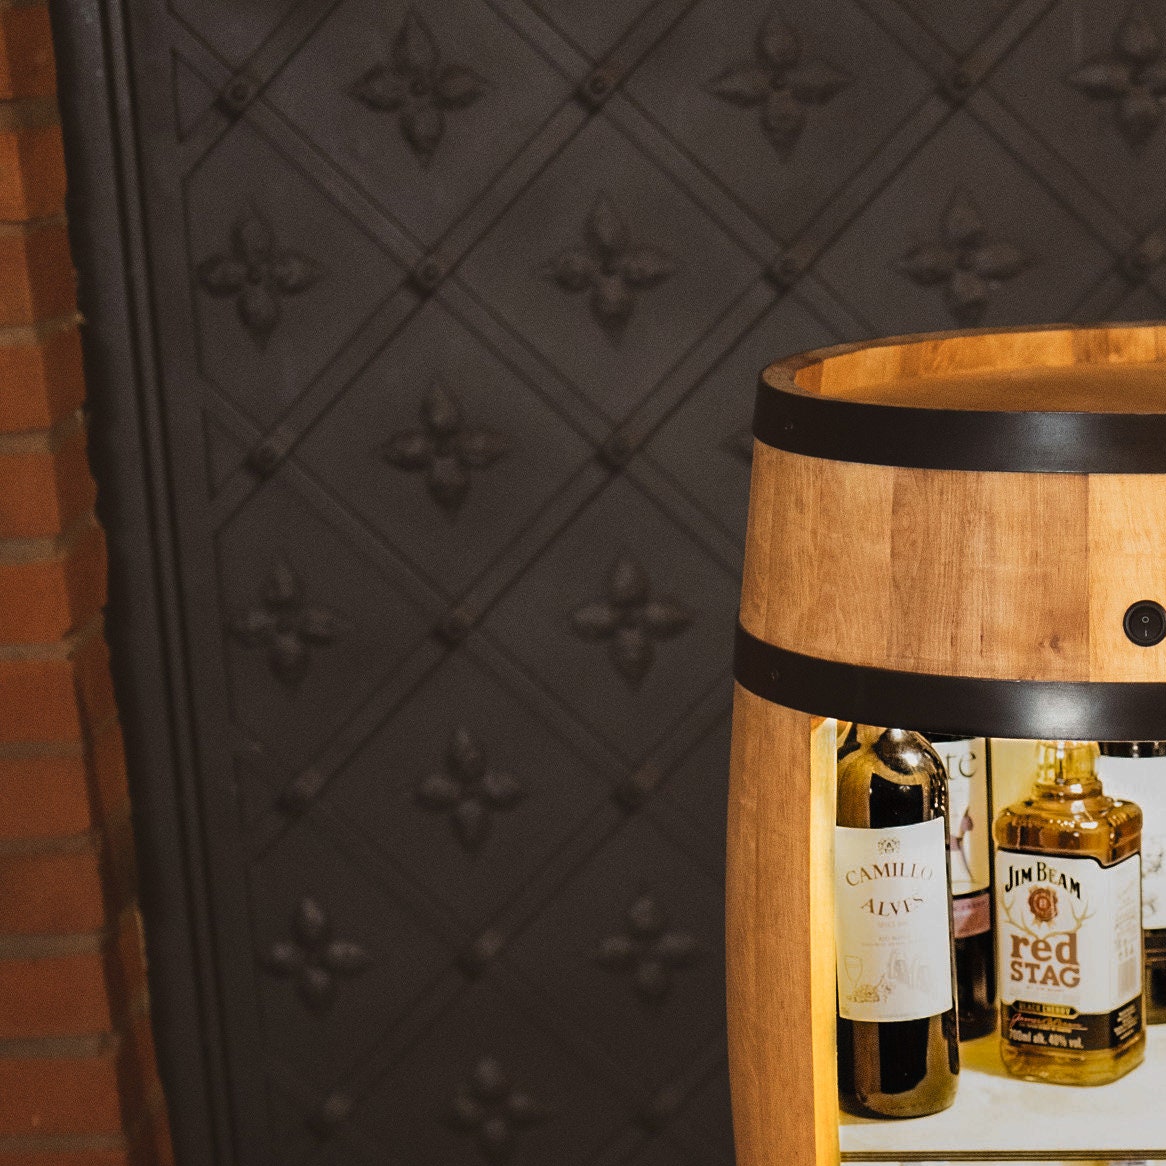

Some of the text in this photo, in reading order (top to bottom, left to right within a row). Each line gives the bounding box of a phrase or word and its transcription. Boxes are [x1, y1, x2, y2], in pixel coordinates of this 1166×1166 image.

[845, 862, 933, 886] CAMILLO
[1005, 861, 1081, 900] JIM BEAM
[1010, 932, 1080, 966] red
[1010, 960, 1081, 988] STAG
